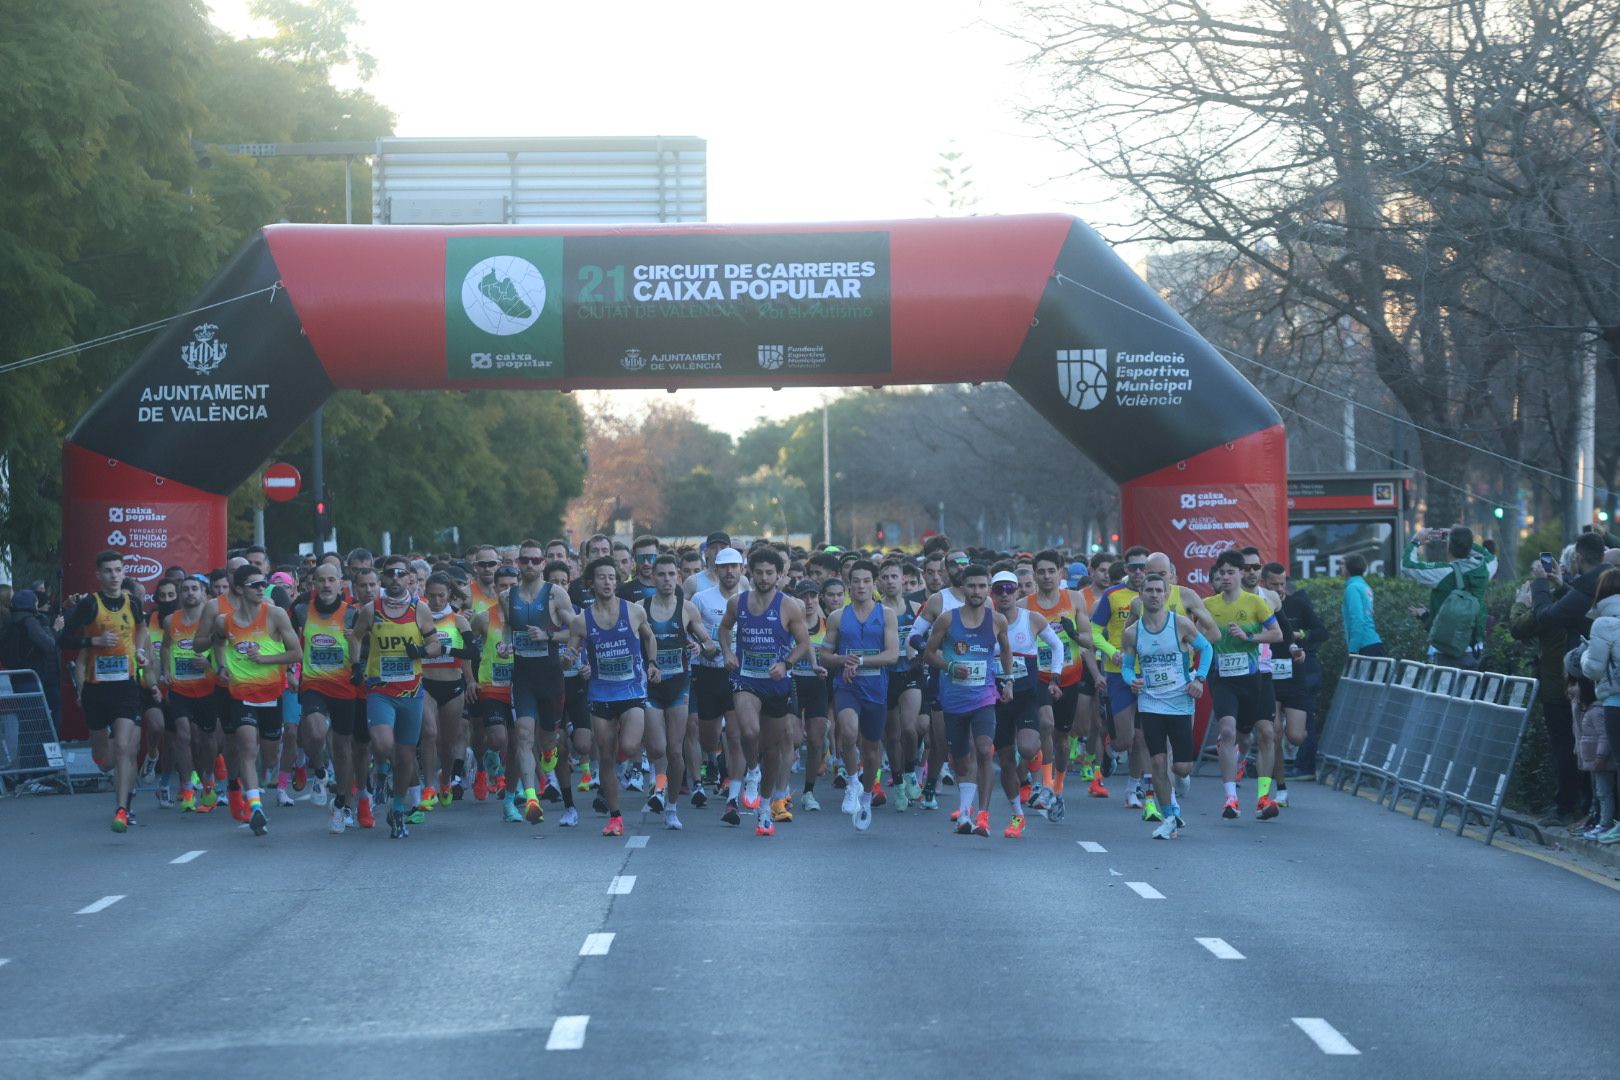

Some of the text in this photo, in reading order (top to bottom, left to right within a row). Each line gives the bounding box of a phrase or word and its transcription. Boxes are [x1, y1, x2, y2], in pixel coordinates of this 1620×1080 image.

[633, 261, 876, 280] CIRCUIT DE CARRERES
[577, 265, 625, 302] 21
[633, 279, 861, 301] CAIXA POPULAR
[636, 303, 654, 318] DE
[495, 352, 532, 361] caixa
[651, 353, 722, 362] AJUNTAMENT
[1116, 351, 1185, 363] Fundació
[496, 360, 553, 368] popular
[1116, 365, 1190, 380] Esportiva
[1116, 378, 1192, 394] Municipal
[140, 384, 269, 402] AJUNTAMENT
[1116, 393, 1183, 406] València
[138, 402, 268, 422] DE VALÈNCIA
[1198, 492, 1223, 500] caixa
[1198, 499, 1238, 507] popular
[126, 513, 166, 522] popular
[129, 541, 168, 549] ALFONSO
[123, 563, 158, 574] errano
[378, 636, 413, 650] UPV
[595, 639, 627, 650] POBLATS
[97, 660, 124, 669] 2441
[1224, 658, 1242, 667] 377
[1274, 663, 1286, 671] 74
[1154, 672, 1169, 682] 28
